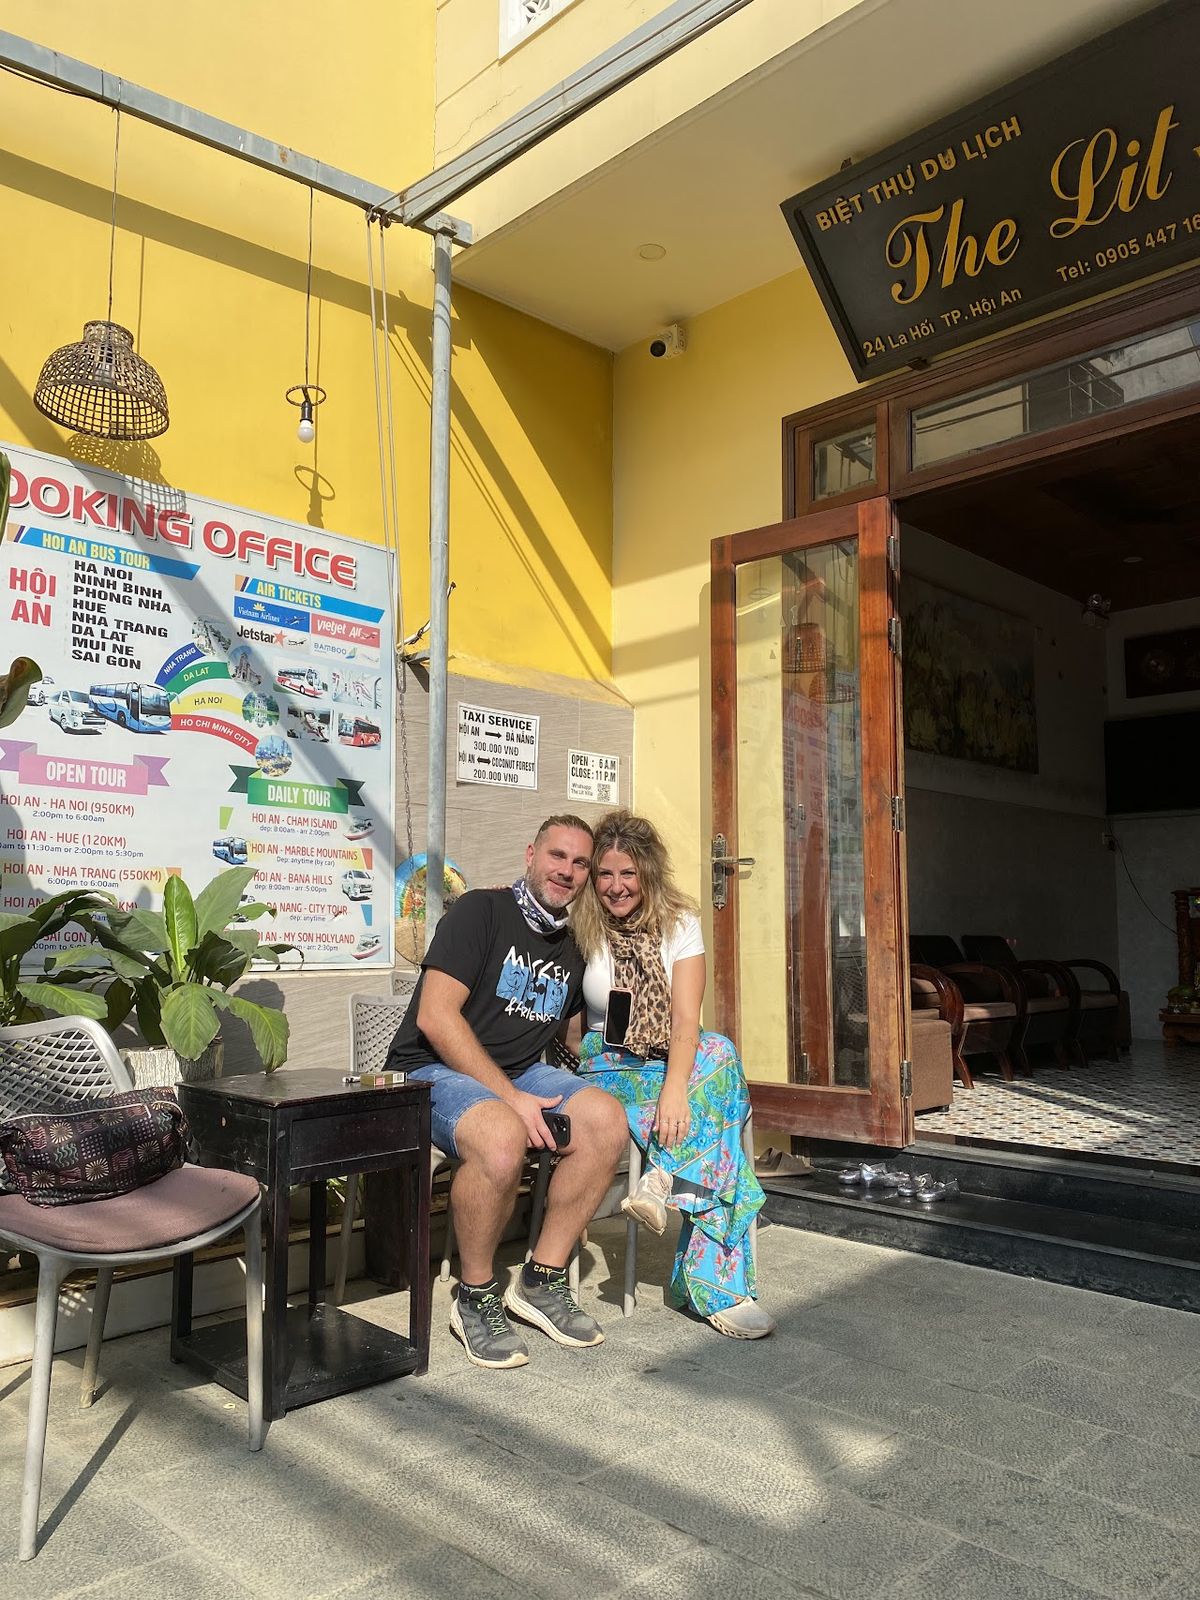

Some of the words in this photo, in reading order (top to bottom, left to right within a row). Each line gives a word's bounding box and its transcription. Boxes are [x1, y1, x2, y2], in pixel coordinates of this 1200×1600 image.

[815, 193, 864, 232] BIỆT
[867, 164, 916, 205] THỰ
[961, 115, 1022, 161] LỊCH
[885, 197, 1020, 305] The
[1049, 104, 1180, 239] Lit
[1056, 260, 1091, 282] Tel:
[1095, 238, 1140, 268] 0905
[1145, 222, 1177, 249] 447
[862, 336, 886, 358] 24
[888, 333, 908, 349] La
[909, 319, 935, 341] Hối
[969, 298, 997, 316] Hội
[1000, 287, 1022, 307] An
[42, 532, 65, 548] HOI
[69, 539, 87, 556] AN
[90, 544, 116, 561] BUS
[119, 550, 150, 569] TOUR
[202, 520, 356, 589] OFFICE
[74, 560, 98, 574] HA
[103, 566, 133, 581] NOI
[9, 567, 57, 600] HỘI
[73, 572, 117, 590] NINH
[122, 582, 163, 599] BINH
[73, 585, 133, 606] PHONG
[138, 597, 172, 613] NHA
[256, 581, 276, 597] AIR
[278, 586, 322, 608] TICKETS
[11, 599, 51, 627] AN
[72, 598, 107, 614] HUE
[238, 606, 259, 618] Vietnam
[260, 612, 280, 622] Airlines
[71, 624, 95, 637] DA
[100, 629, 128, 643] LAT
[72, 611, 108, 627] NHA
[113, 619, 169, 638] TRANG
[236, 625, 275, 643] Jetstar
[72, 637, 106, 651] MUI
[111, 643, 134, 656] NE
[71, 650, 100, 663] SAI
[106, 655, 141, 670] GON
[163, 660, 177, 675] NHA
[175, 647, 196, 664] TRANG
[183, 672, 194, 682] DA
[195, 666, 210, 677] LAT
[194, 697, 206, 706] HA
[207, 696, 223, 704] NOI
[463, 710, 485, 723] TAXI
[488, 715, 532, 731] SERVICE
[181, 718, 194, 726] HO
[195, 720, 210, 728] CHI
[211, 722, 233, 736] MINH
[233, 731, 253, 747] CITY
[470, 725, 480, 737] AN
[473, 741, 502, 754] 300.000
[503, 745, 520, 756] VNĐ
[468, 753, 475, 764] AN
[491, 757, 515, 770] COCONUT
[515, 759, 535, 772] FOREST
[571, 754, 588, 766] OPEN
[599, 758, 603, 769] 6
[46, 761, 86, 784] OPEN
[90, 766, 127, 788] TOUR
[473, 769, 502, 781] 200.000
[503, 773, 519, 783] VNĐ
[595, 770, 602, 780] 11
[267, 784, 299, 804] DAILY
[302, 788, 331, 807] TOUR
[0, 794, 21, 806] HOI
[23, 796, 40, 807] AN
[50, 798, 66, 810] HA
[69, 799, 88, 811] NOI
[90, 802, 135, 818] (950KM)
[32, 810, 63, 819] 2:00pm
[75, 814, 105, 823] 6:00am
[252, 812, 266, 823] HOI
[268, 814, 280, 824] AN
[286, 815, 309, 827] CHAM
[310, 818, 338, 830] ISLAND
[7, 828, 27, 840] HOI
[30, 830, 47, 841] AN
[56, 832, 79, 844] HUE
[82, 834, 127, 850] (120KM)
[74, 847, 104, 856] 2:00pm
[115, 850, 144, 858] 5:30pm
[251, 843, 265, 853] HOI
[266, 844, 279, 854] AN
[284, 845, 315, 857] MARBLE
[316, 847, 358, 860] MOUNTAINS
[3, 863, 24, 874] HOI
[27, 864, 44, 875] AN
[53, 865, 77, 877] NHA
[80, 867, 116, 880] TRANG
[119, 869, 162, 882] (550KM)
[269, 872, 282, 882] AN
[288, 873, 310, 884] BANA
[312, 875, 333, 885] HILLS
[47, 877, 78, 886] 6:00pm
[90, 880, 119, 888] 6:00am
[4, 896, 24, 908] HOI
[279, 902, 302, 912] NANG
[308, 903, 326, 914] CITY
[64, 931, 87, 942] GON
[265, 931, 277, 942] AN
[283, 932, 296, 942] MY
[297, 932, 314, 942] SON
[315, 933, 355, 944] HOLYLAND
[503, 945, 571, 986] MICKEY
[533, 1264, 552, 1274] CAT
